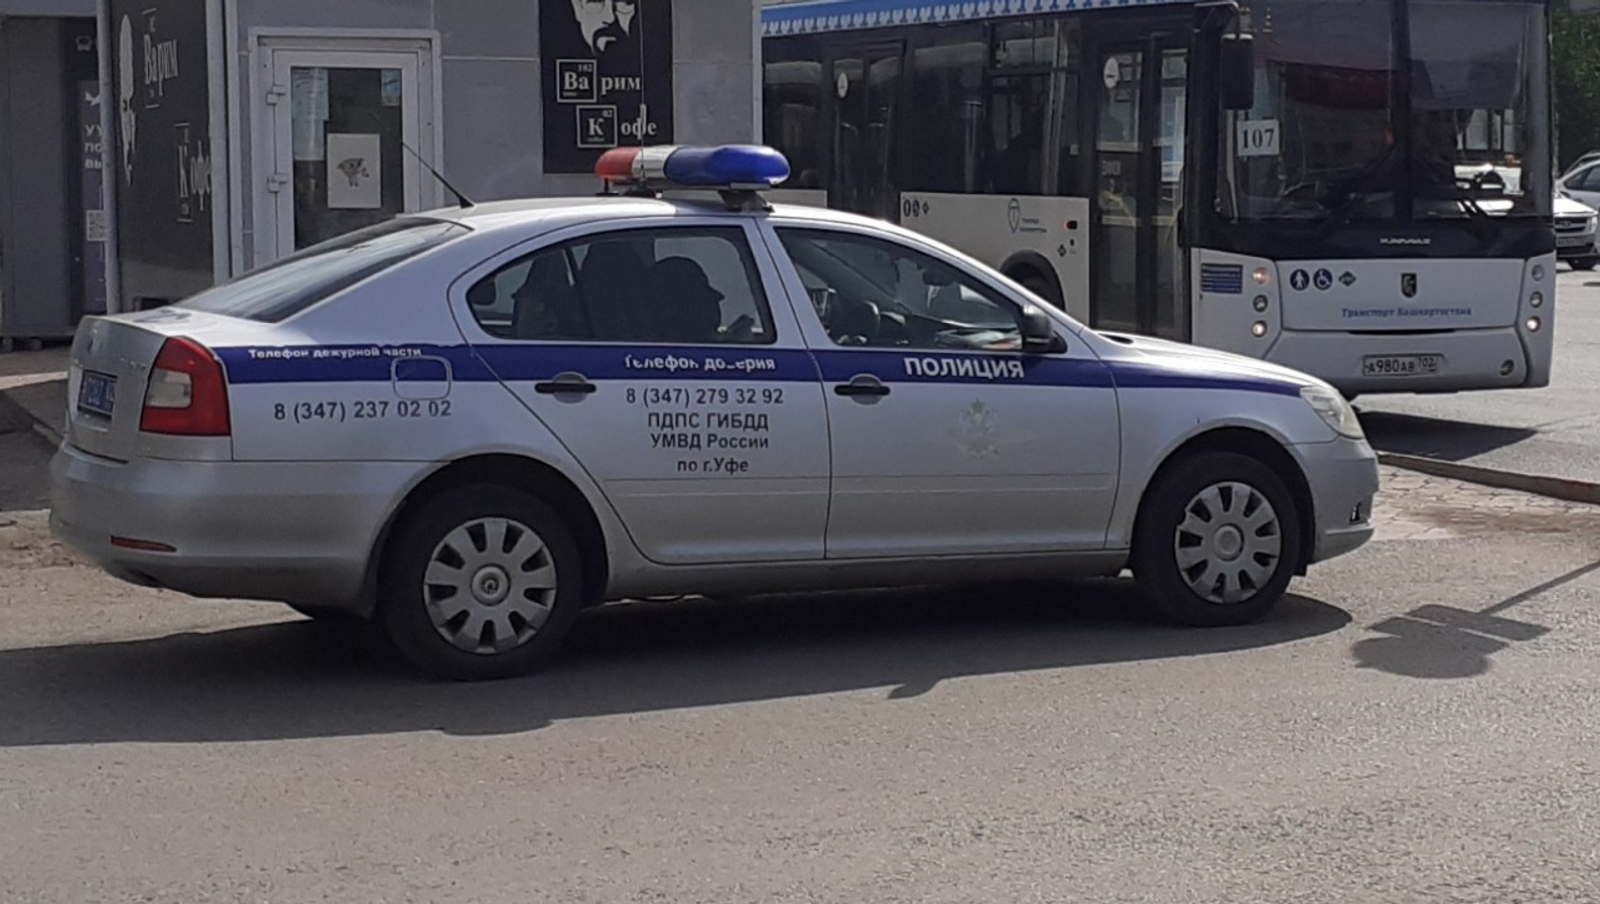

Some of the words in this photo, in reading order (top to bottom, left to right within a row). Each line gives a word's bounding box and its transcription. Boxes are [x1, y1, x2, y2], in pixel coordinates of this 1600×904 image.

[1243, 128, 1275, 149] 107
[248, 349, 309, 360] Телефон
[313, 347, 380, 360] дежурной
[383, 348, 423, 358] части
[903, 356, 1025, 380] ПОЛИЦИЯ
[626, 387, 637, 404] 8
[642, 387, 691, 408] (347)
[696, 387, 729, 404] 279
[735, 388, 757, 404] 32
[762, 388, 784, 404] 92
[274, 402, 286, 421] 8
[293, 401, 346, 424] (347)
[353, 401, 390, 419] 237
[397, 400, 422, 418] 02
[428, 400, 452, 418] 02
[647, 412, 700, 431] ПДПС
[706, 413, 769, 431] ГИБДД
[650, 433, 702, 451] УМВД
[706, 433, 769, 449] России
[677, 460, 698, 473] по
[703, 457, 749, 475] г.Уфе
